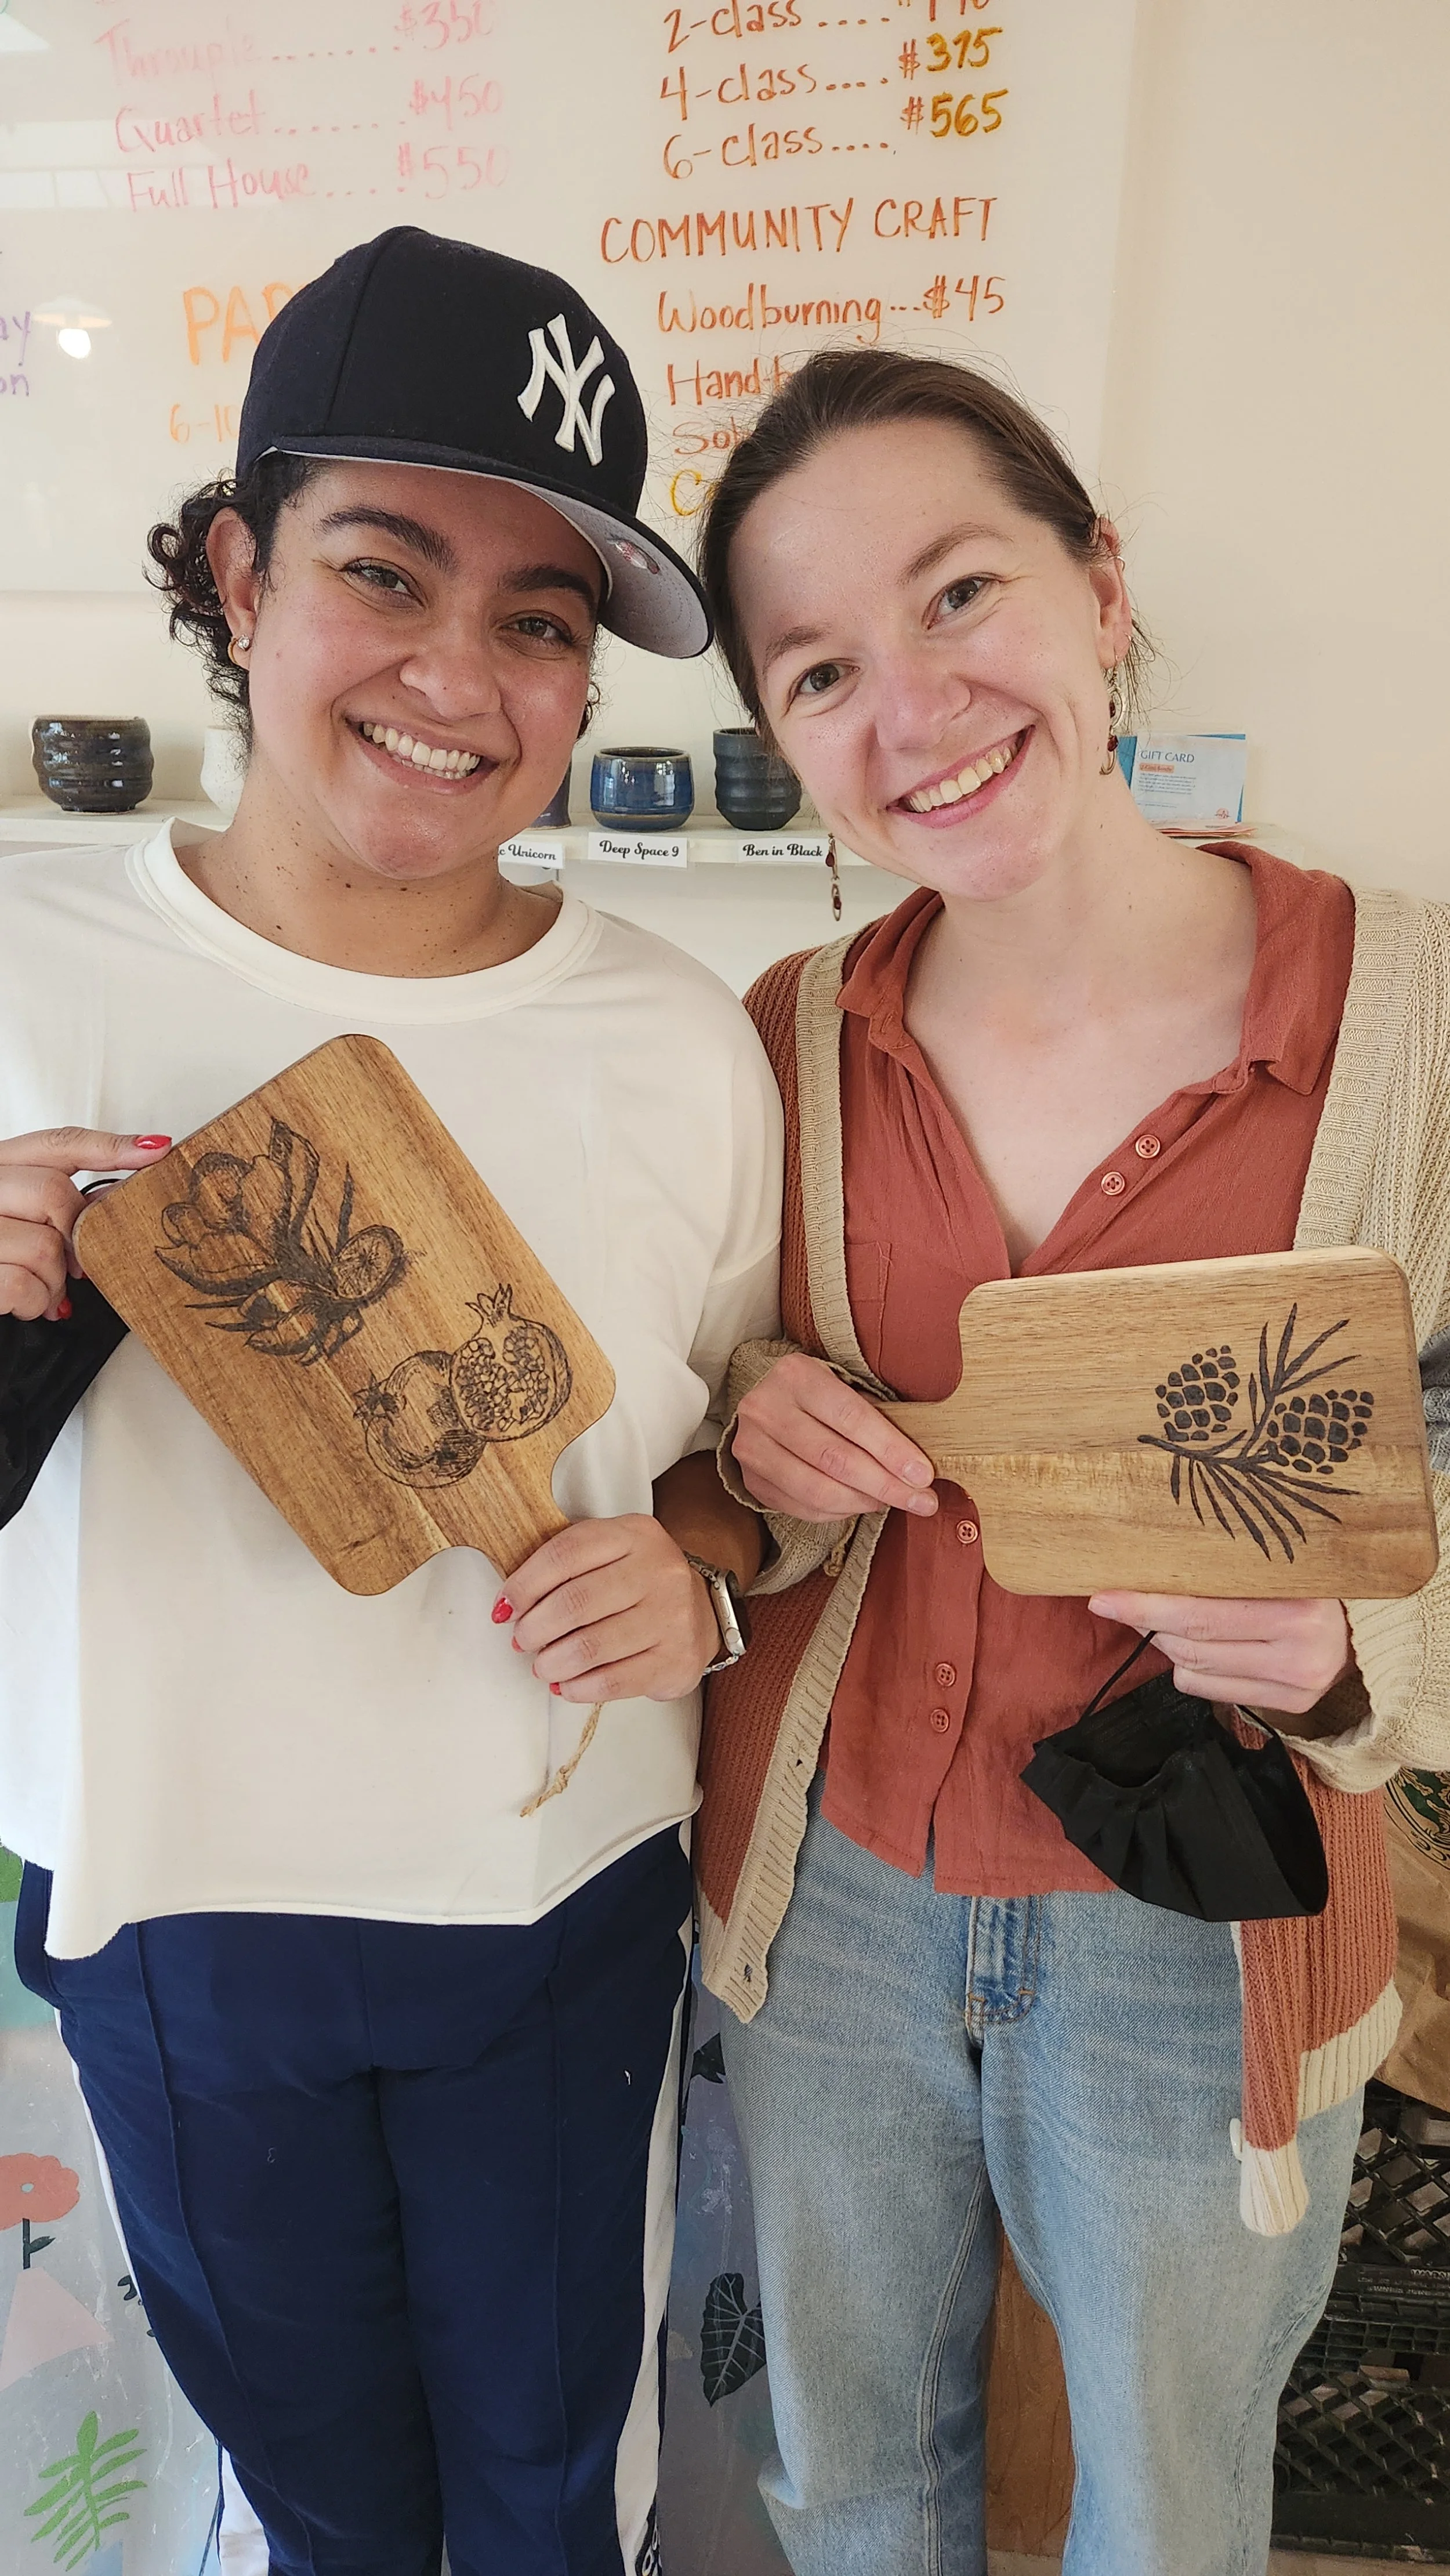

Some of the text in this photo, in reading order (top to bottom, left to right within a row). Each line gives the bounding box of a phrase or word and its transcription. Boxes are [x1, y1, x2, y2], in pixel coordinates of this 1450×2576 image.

[115, 89, 266, 152] Quartet
[128, 169, 188, 212] Full
[208, 158, 316, 209] House
[600, 197, 998, 263] COMMUNITY CRAFT
[658, 283, 882, 345] Woodburning
[517, 313, 616, 466] NY
[1140, 750, 1195, 763] GIFT CARD
[508, 844, 557, 860] Unicorn
[599, 840, 680, 860] Deep Space 9
[742, 843, 822, 857] Ben in Black
